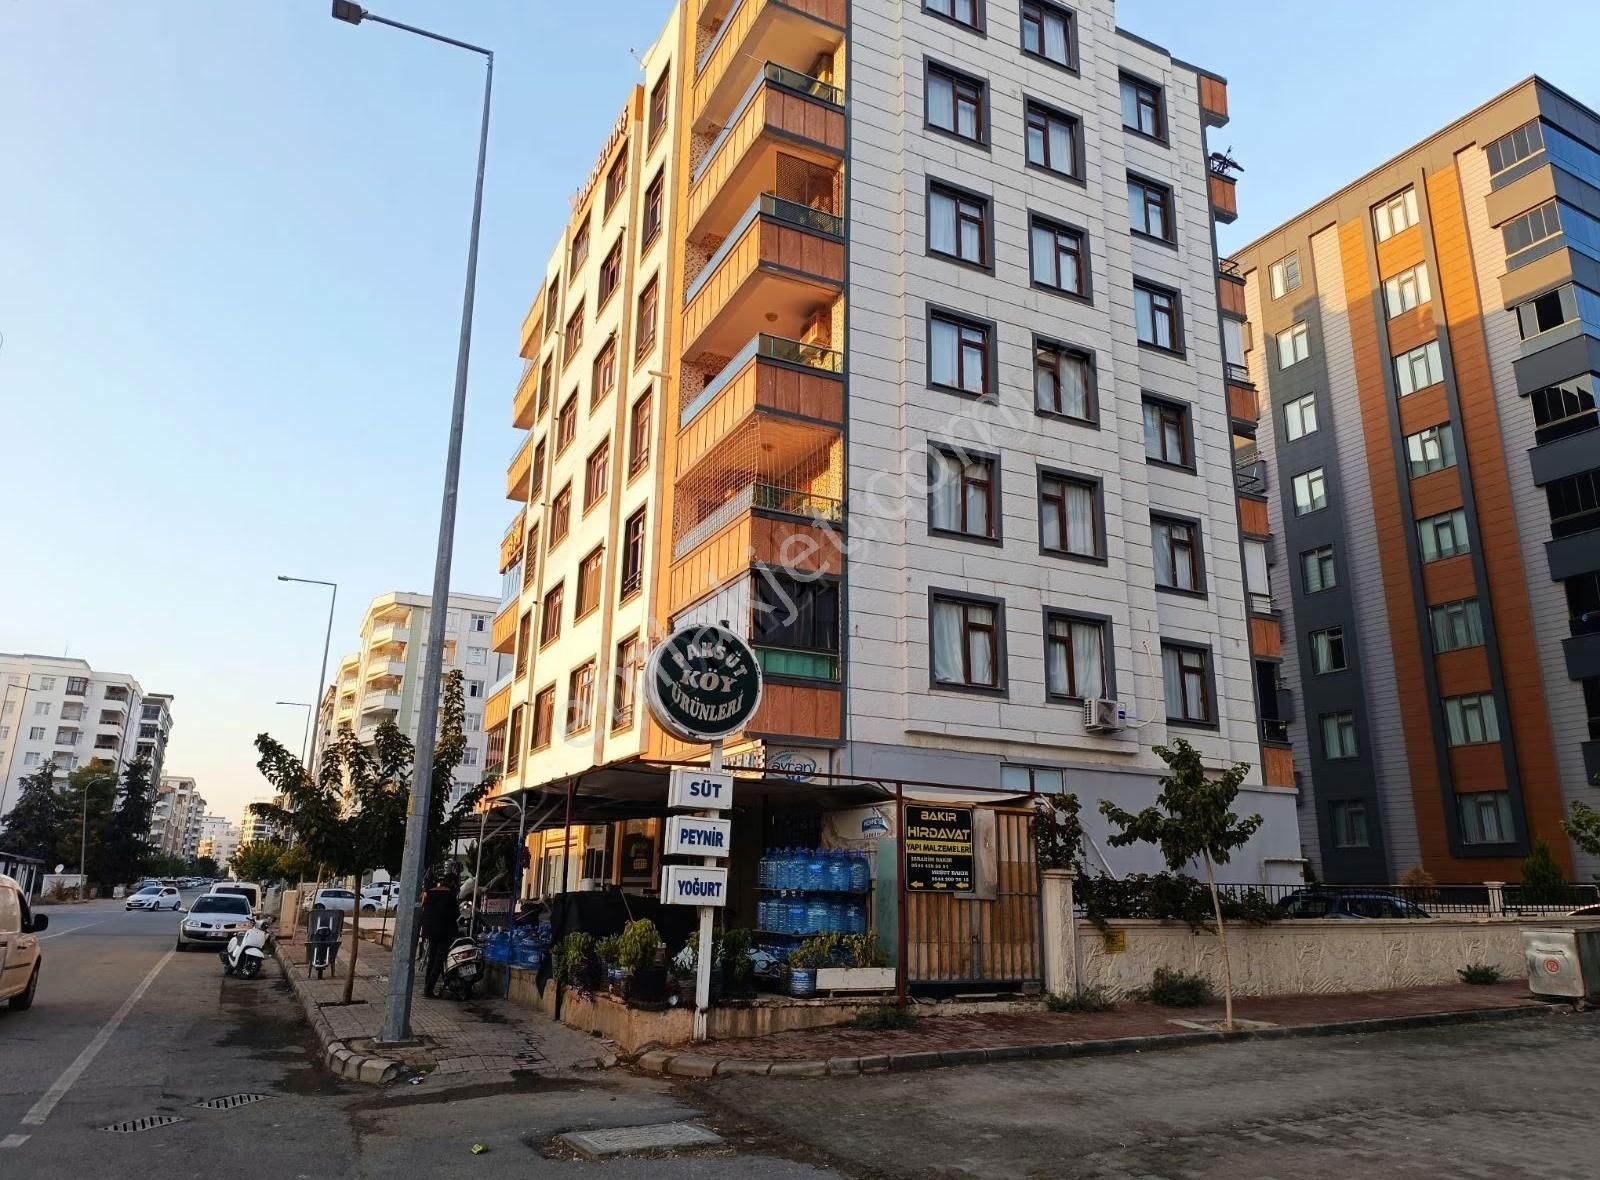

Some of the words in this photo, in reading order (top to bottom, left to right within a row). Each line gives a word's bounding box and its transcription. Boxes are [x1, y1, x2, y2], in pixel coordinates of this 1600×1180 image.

[679, 667, 738, 692] KÖY
[671, 680, 744, 721] ÜRÜNLERİ
[689, 779, 722, 798] SÜT
[920, 810, 957, 822] BAKIR
[680, 826, 724, 847] PEYNİR
[907, 825, 970, 840] HIRDAVAT
[906, 843, 922, 852] YAPI
[677, 877, 722, 897] YOĞURT
